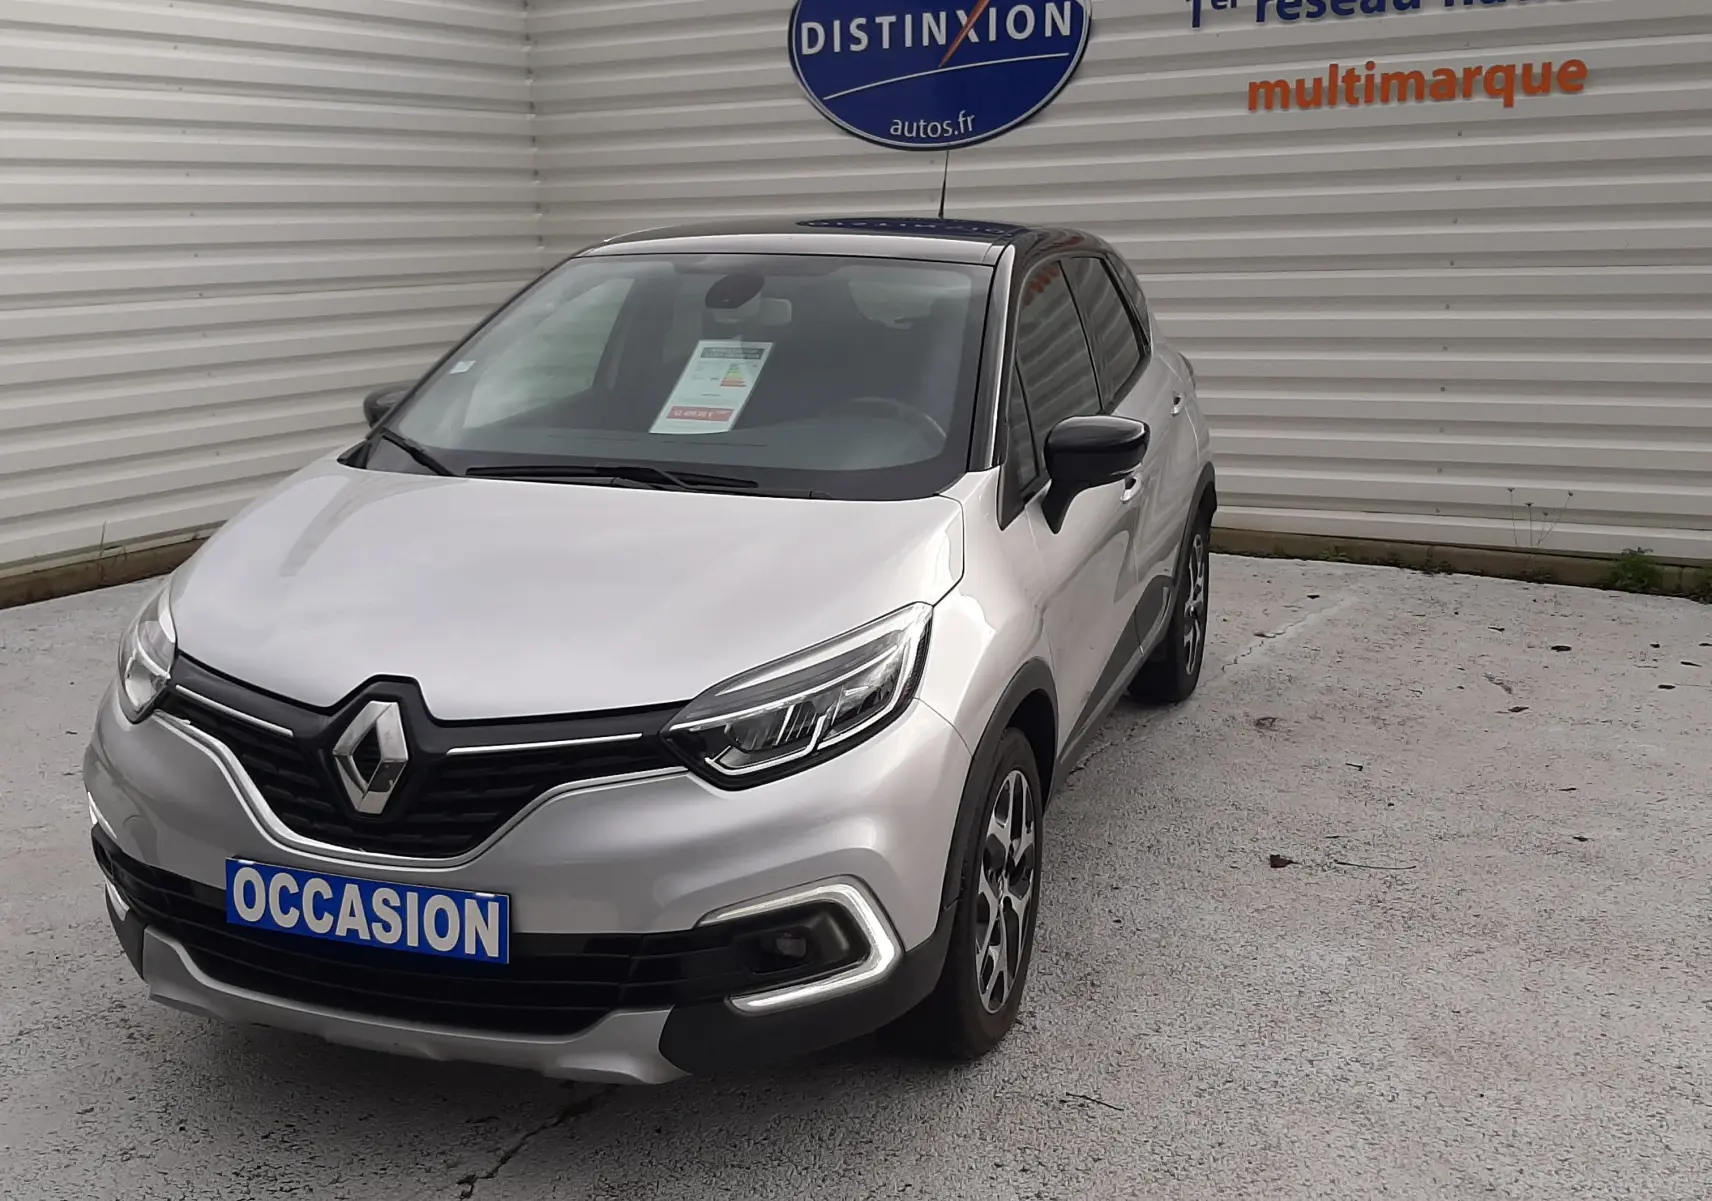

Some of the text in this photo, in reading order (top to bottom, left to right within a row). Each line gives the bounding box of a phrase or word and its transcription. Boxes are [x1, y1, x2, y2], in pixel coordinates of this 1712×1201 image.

[801, 0, 1071, 56] DISTINXION
[1248, 60, 1588, 108] multimarque
[890, 110, 975, 138] autos.fr
[233, 866, 500, 957] OCCASION
